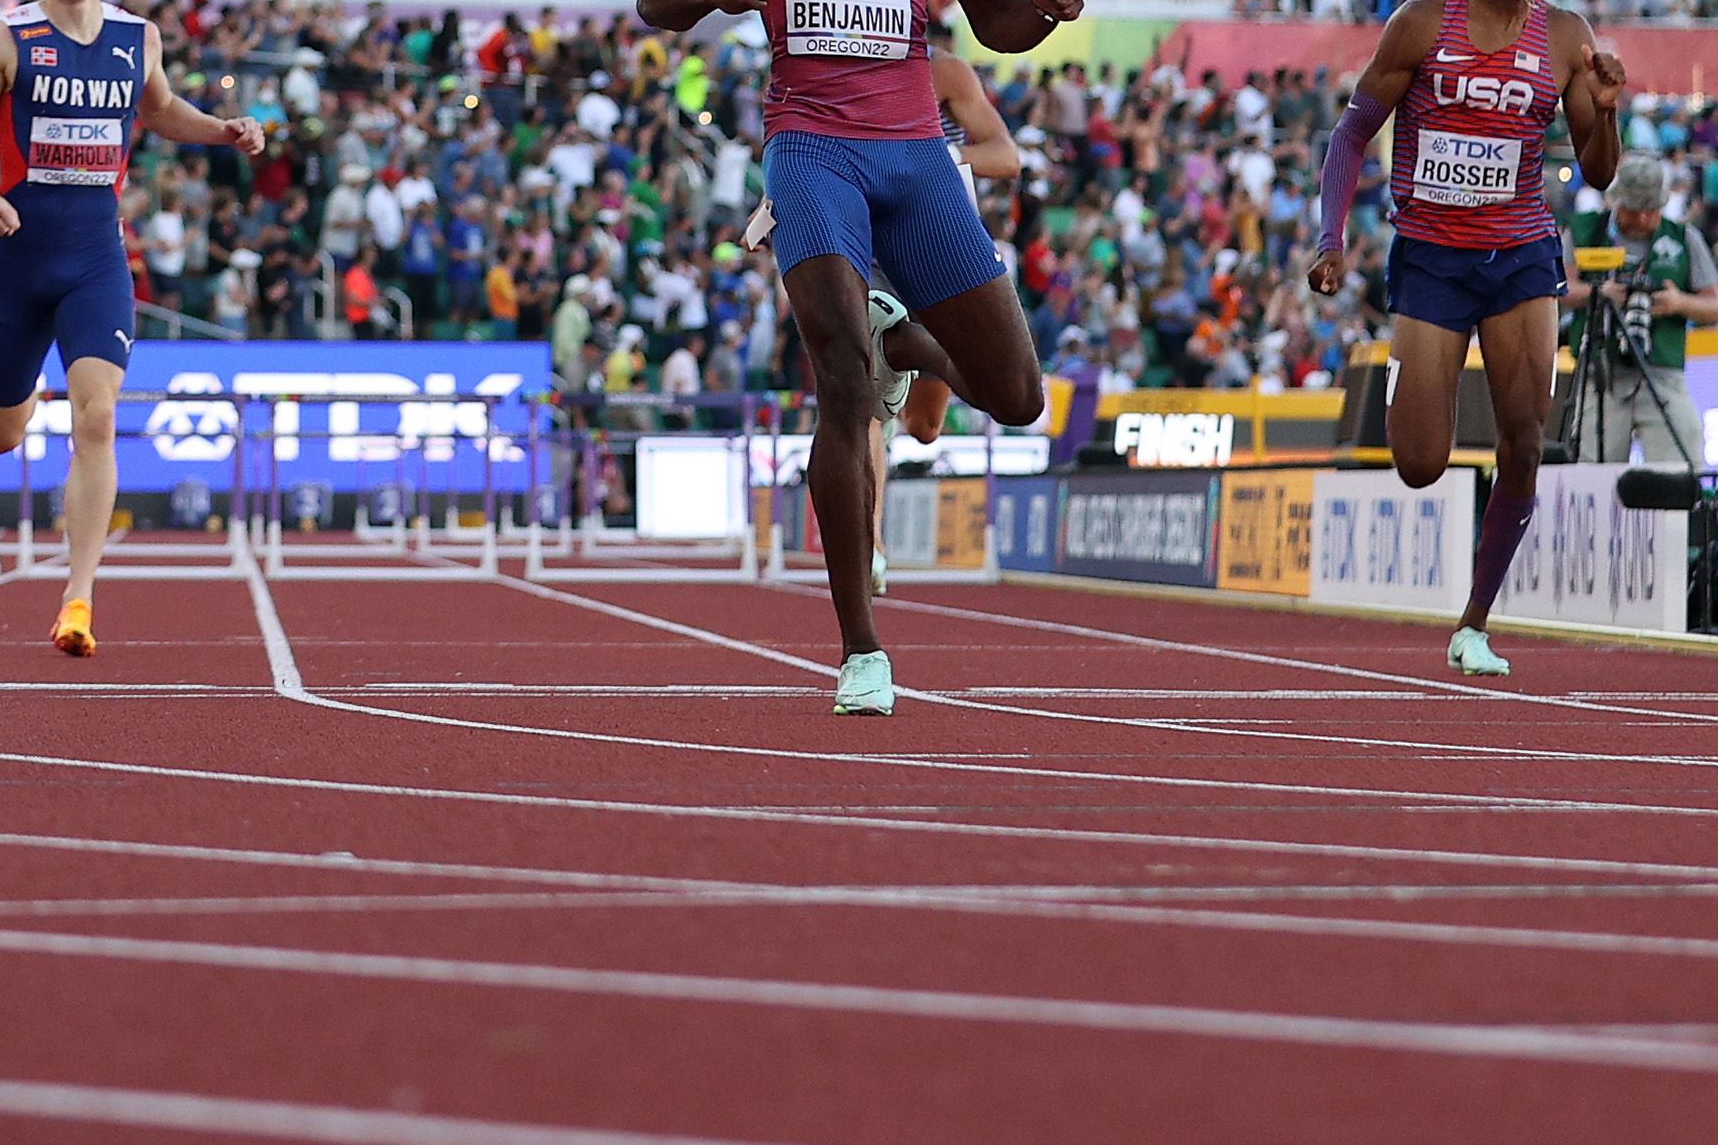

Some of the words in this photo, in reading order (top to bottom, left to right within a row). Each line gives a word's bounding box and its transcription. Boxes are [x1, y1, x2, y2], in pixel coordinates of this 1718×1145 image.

[794, 2, 904, 35] BENJAMIN
[806, 39, 890, 56] OREGON22
[32, 74, 134, 108] NORWAY
[1433, 73, 1534, 115] USA
[62, 125, 109, 140] TDK
[35, 145, 118, 166] WARHOLM
[1449, 139, 1507, 161] TDK
[1421, 159, 1510, 188] ROSSER
[233, 373, 524, 463] TDK
[1114, 412, 1234, 467] FINISH
